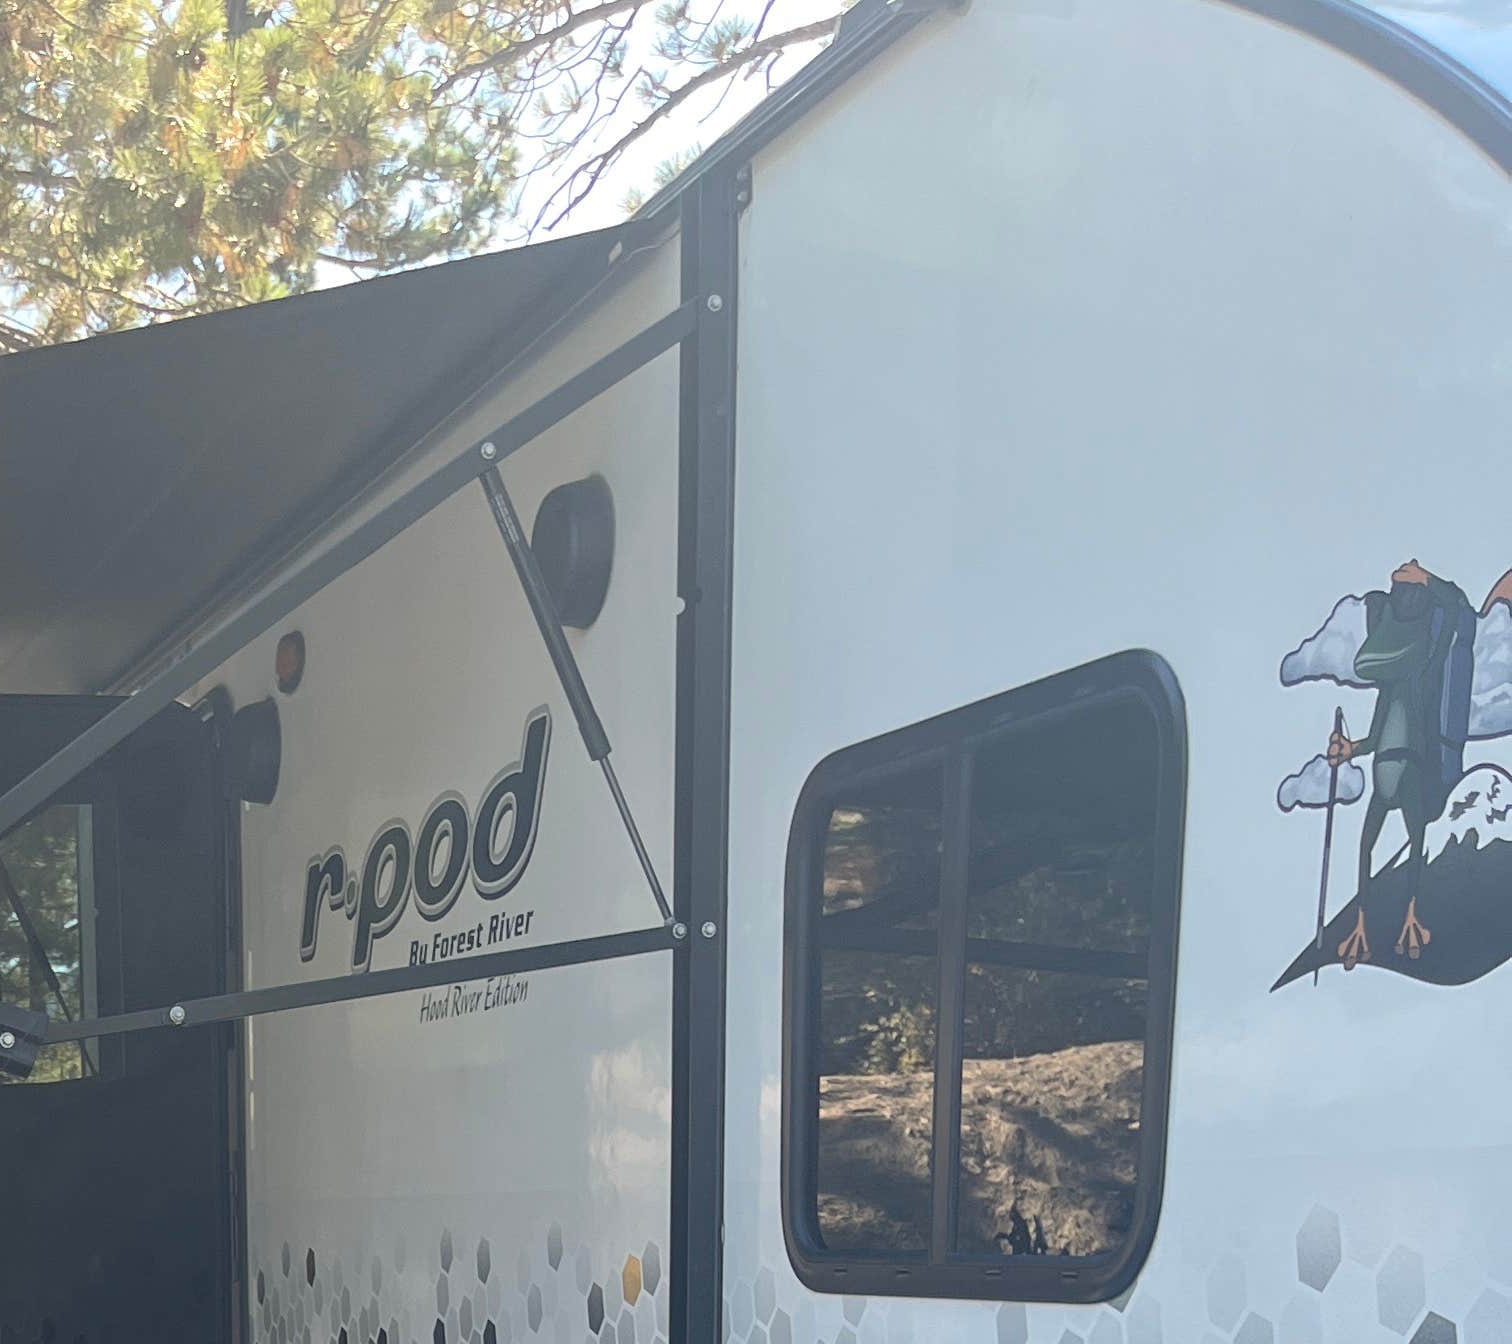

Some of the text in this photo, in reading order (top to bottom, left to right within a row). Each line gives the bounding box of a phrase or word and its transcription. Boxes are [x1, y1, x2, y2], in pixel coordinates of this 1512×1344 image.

[431, 922, 484, 962] Forest
[487, 909, 535, 946] River
[419, 974, 529, 1024] Hood River Edition
